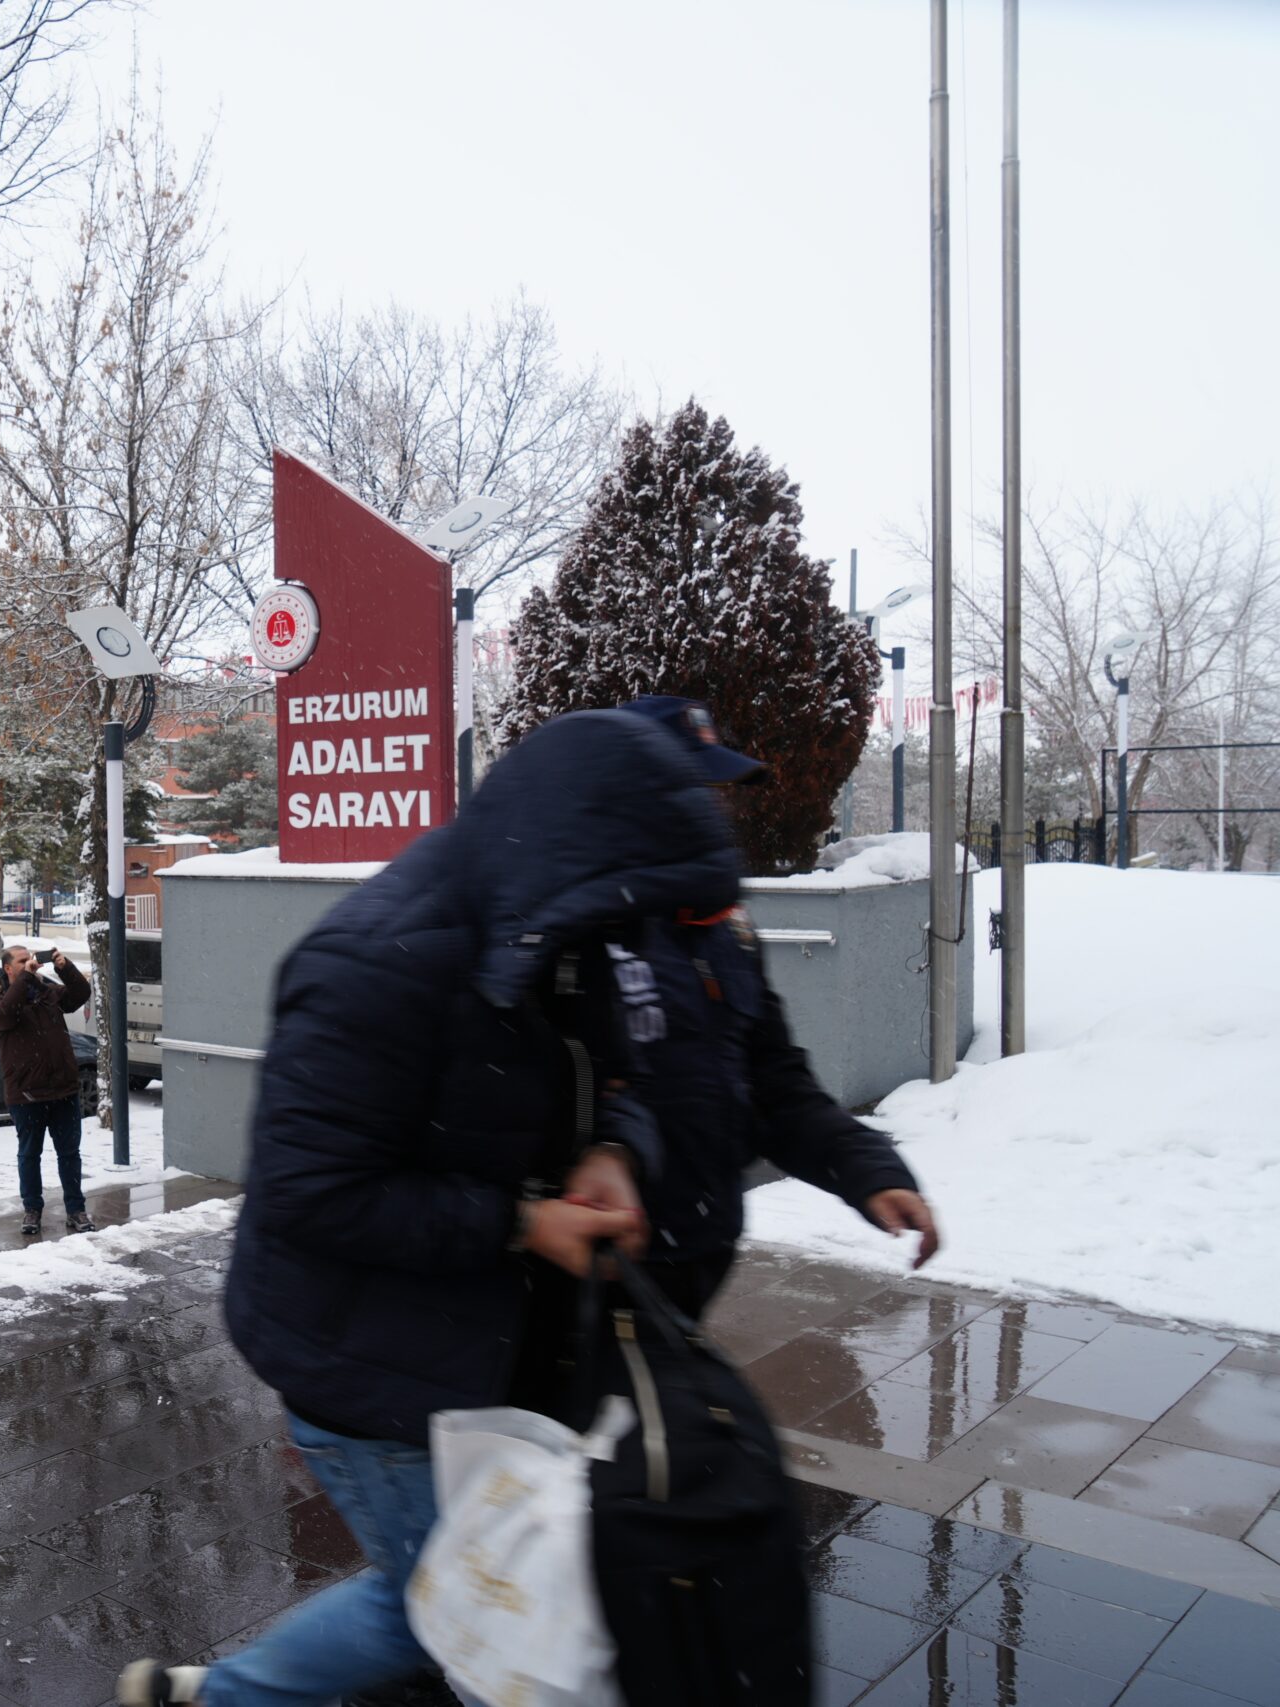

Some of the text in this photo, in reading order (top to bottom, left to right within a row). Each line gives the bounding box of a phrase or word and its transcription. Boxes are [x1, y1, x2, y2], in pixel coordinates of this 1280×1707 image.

[288, 687, 428, 725] ERZURUM
[287, 734, 431, 776] ADALET
[288, 790, 431, 829] SARAYI
